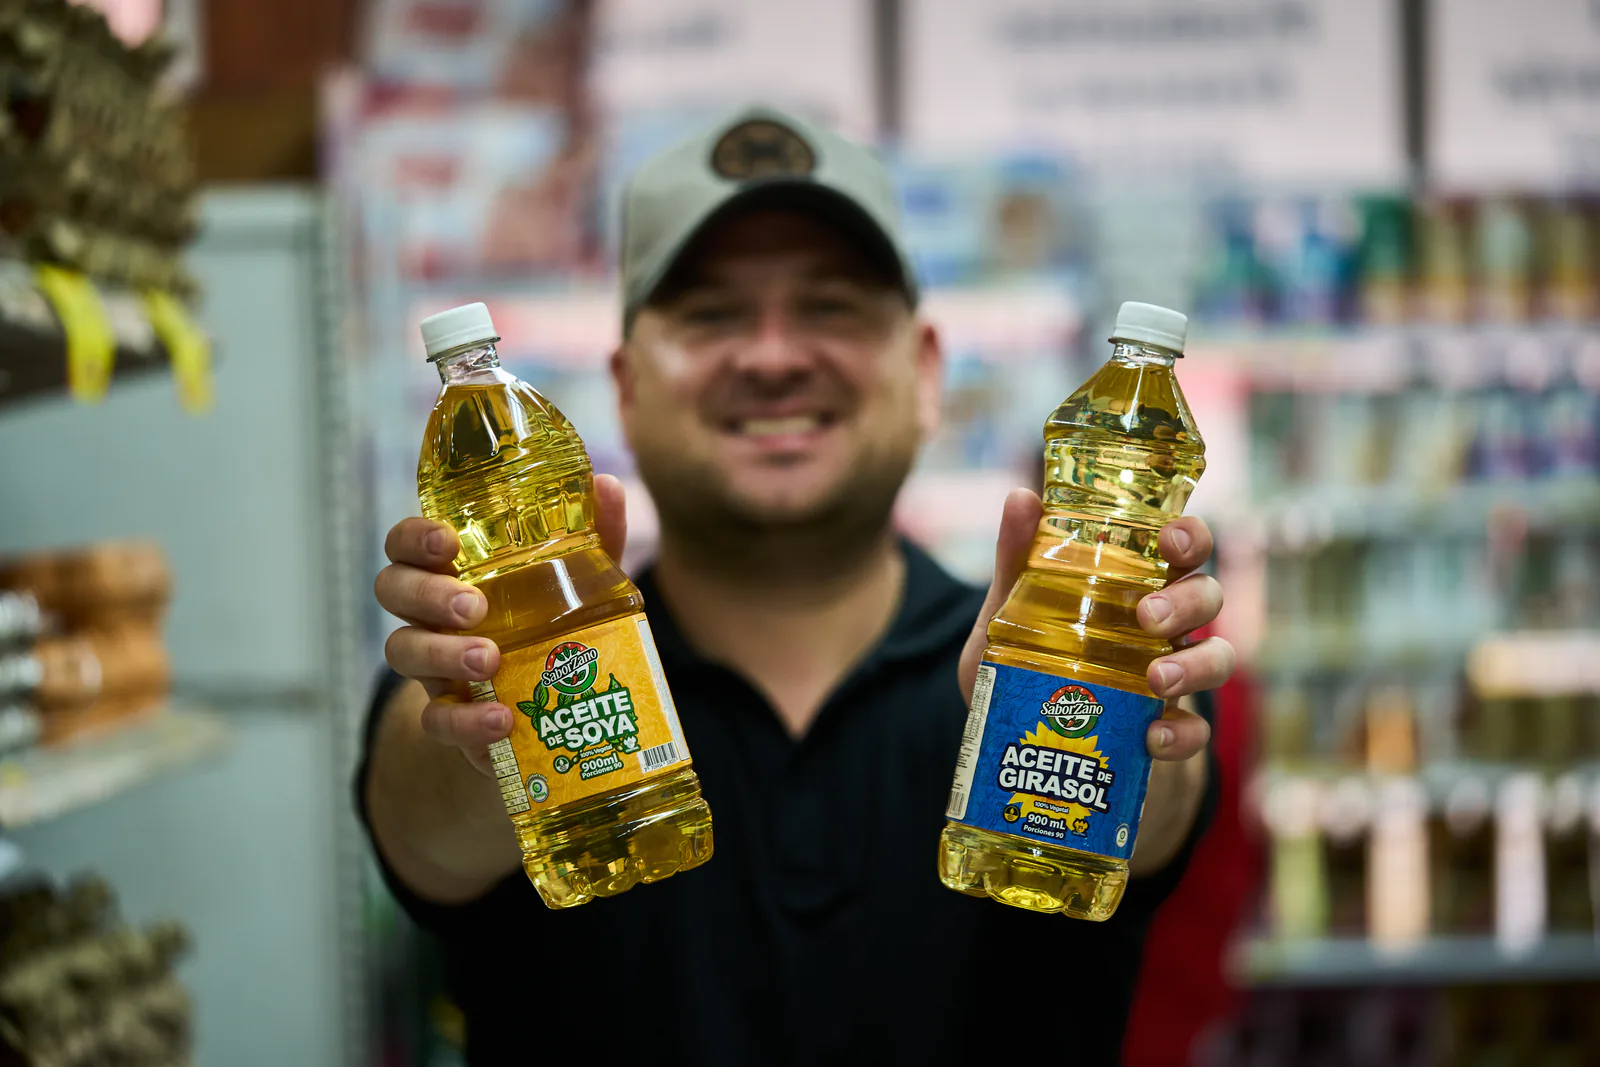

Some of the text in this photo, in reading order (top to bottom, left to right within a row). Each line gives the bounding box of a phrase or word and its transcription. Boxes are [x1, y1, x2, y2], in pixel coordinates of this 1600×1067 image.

[543, 650, 597, 685] SaborZano
[541, 691, 631, 737] ACEITE
[1041, 702, 1103, 715] SaborZano
[548, 717, 636, 749] DE SOYA
[594, 744, 613, 754] Vegetal
[582, 752, 618, 772] 900ml
[582, 762, 622, 779] Porciones 90
[1002, 746, 1113, 784] ACEITE DE
[999, 768, 1108, 810] GIRASOL
[1049, 805, 1069, 814] Vegetal
[1023, 825, 1055, 837] Porciones
[1028, 814, 1066, 830] 900 mL
